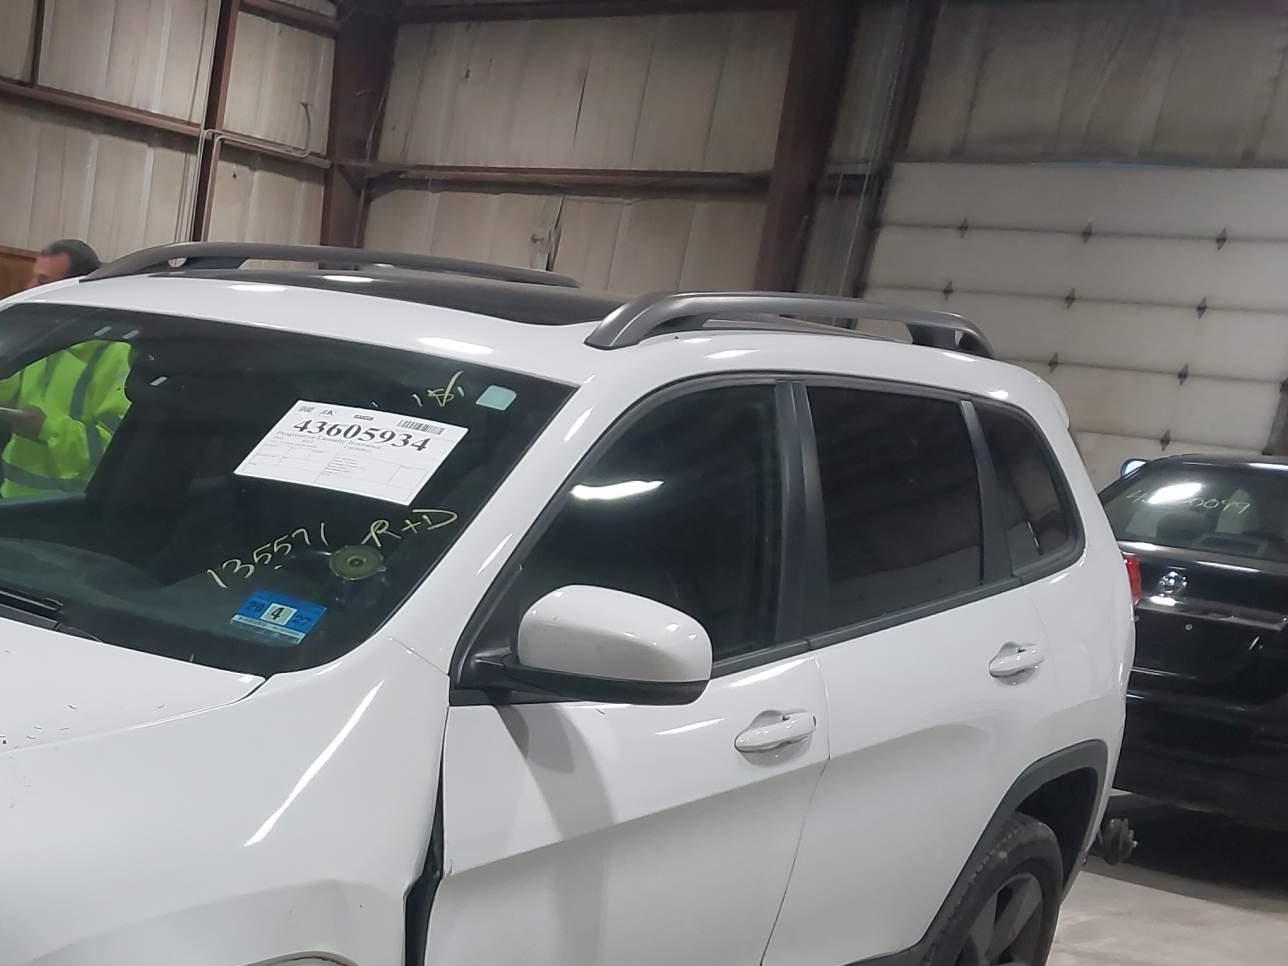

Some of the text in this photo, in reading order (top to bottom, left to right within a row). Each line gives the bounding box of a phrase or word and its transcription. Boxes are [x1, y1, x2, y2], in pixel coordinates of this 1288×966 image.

[293, 419, 433, 452] 43605934
[207, 523, 329, 588] 135571
[271, 607, 282, 620] 4
